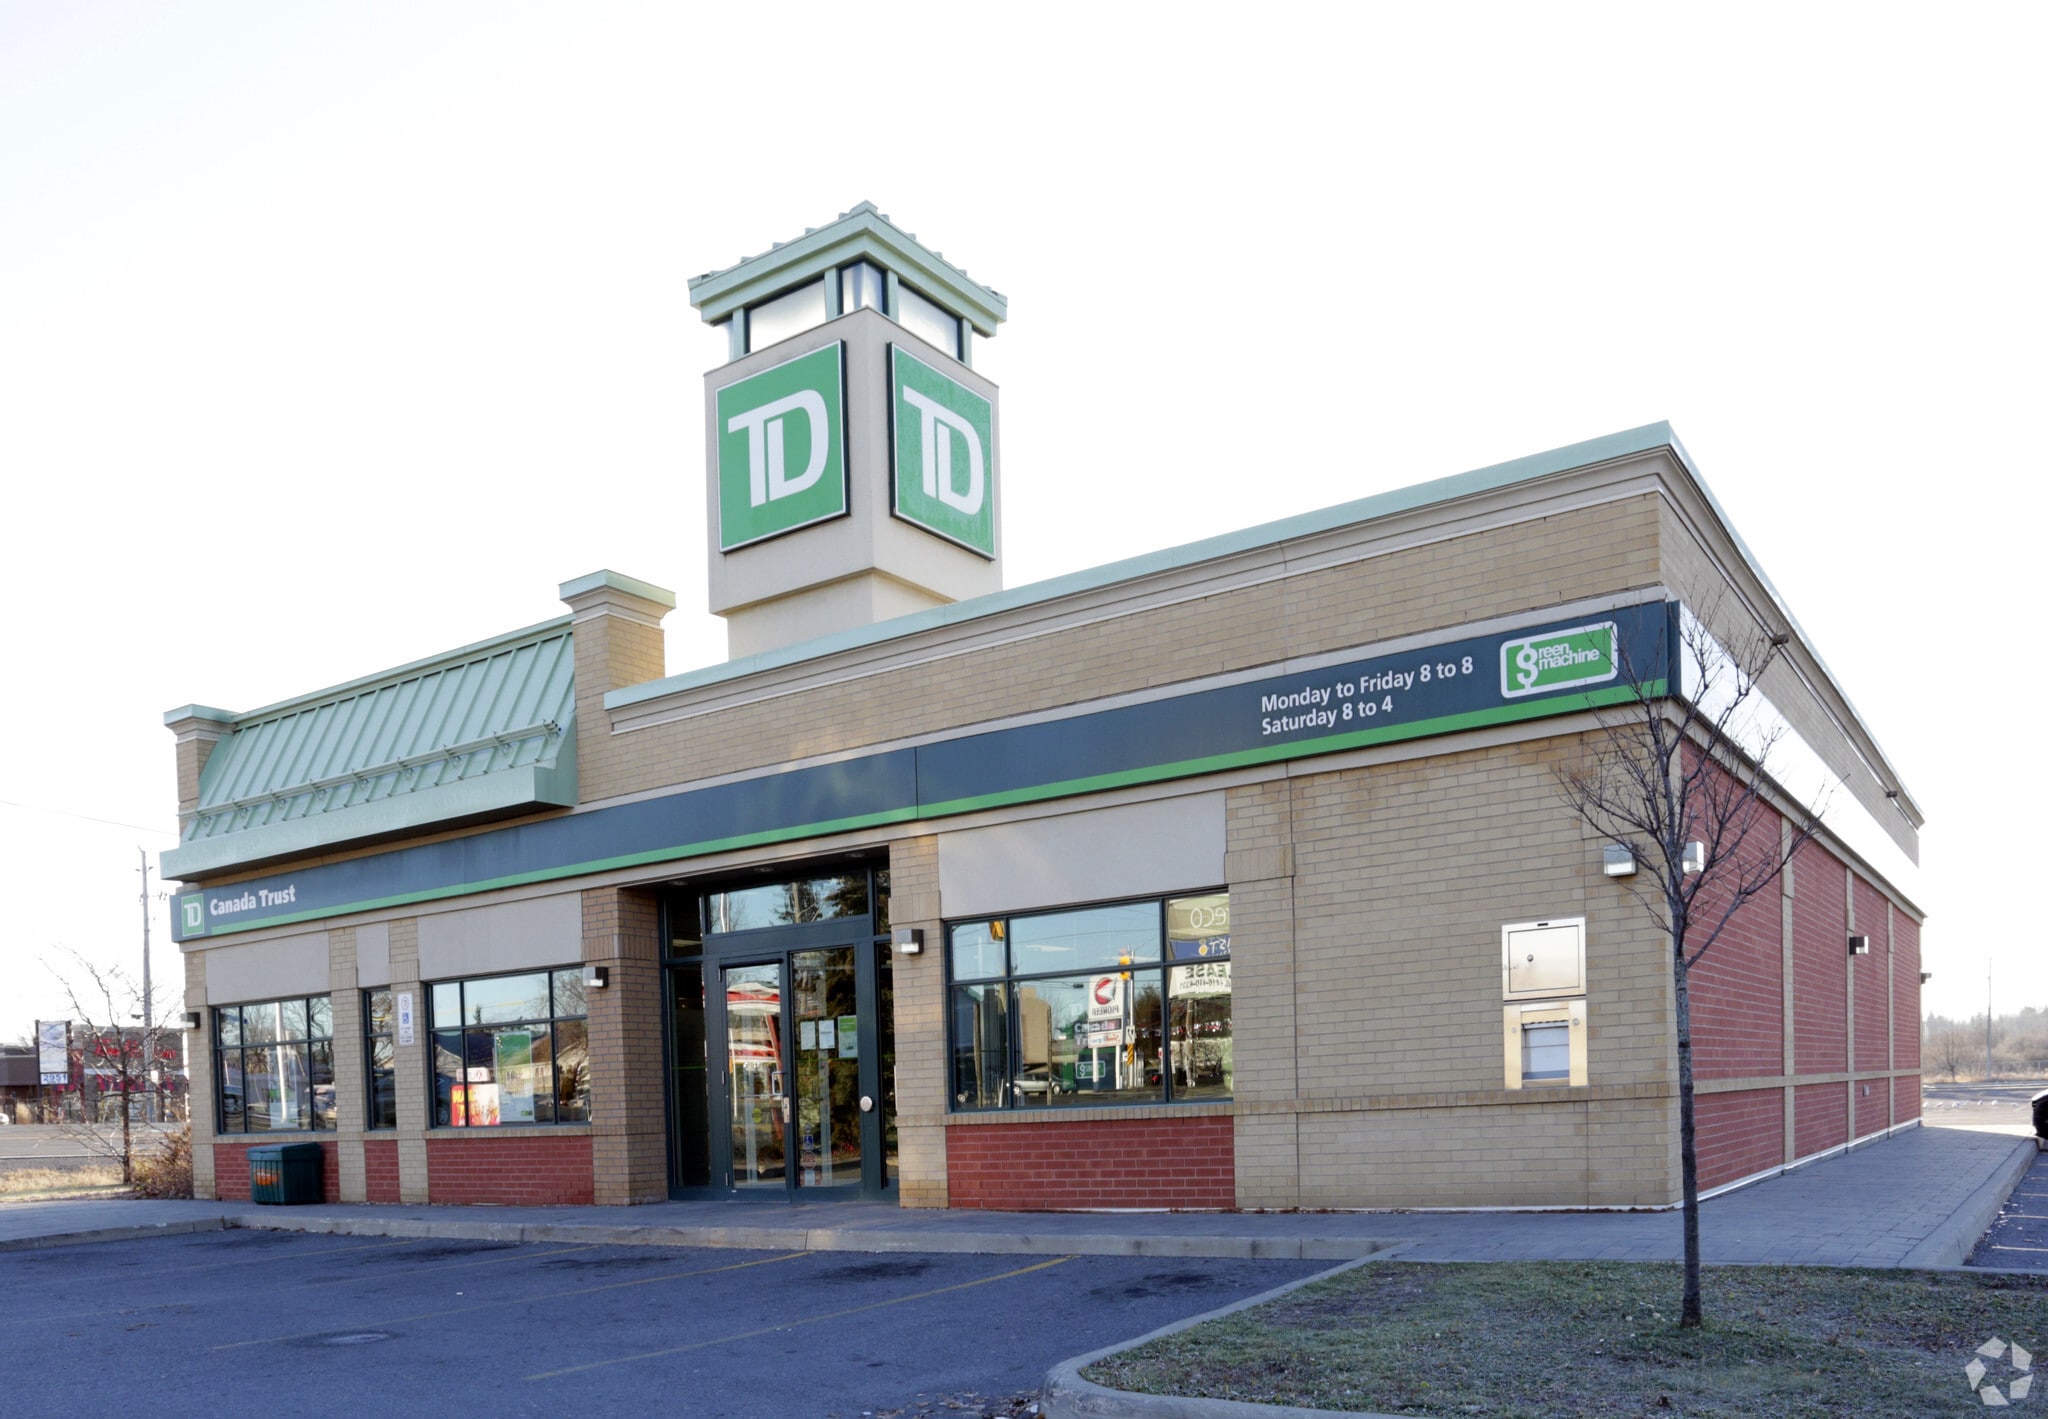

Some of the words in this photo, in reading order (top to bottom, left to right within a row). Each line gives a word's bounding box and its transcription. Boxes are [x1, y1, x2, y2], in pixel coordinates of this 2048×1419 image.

[728, 389, 829, 508] TD
[903, 385, 985, 515] TD
[1539, 648, 1600, 670] machine
[1261, 687, 1331, 712] Monday
[1336, 683, 1354, 698] to
[1360, 670, 1415, 694] Friday
[1420, 664, 1432, 682] 8
[1436, 662, 1456, 678] to
[1461, 656, 1473, 674] 8
[1262, 708, 1337, 735] Saturday
[1342, 703, 1353, 720] 8
[1357, 701, 1376, 718] to
[1381, 695, 1393, 712] 4
[184, 902, 202, 927] TD
[210, 892, 256, 916] Canada
[259, 884, 296, 908] Trust
